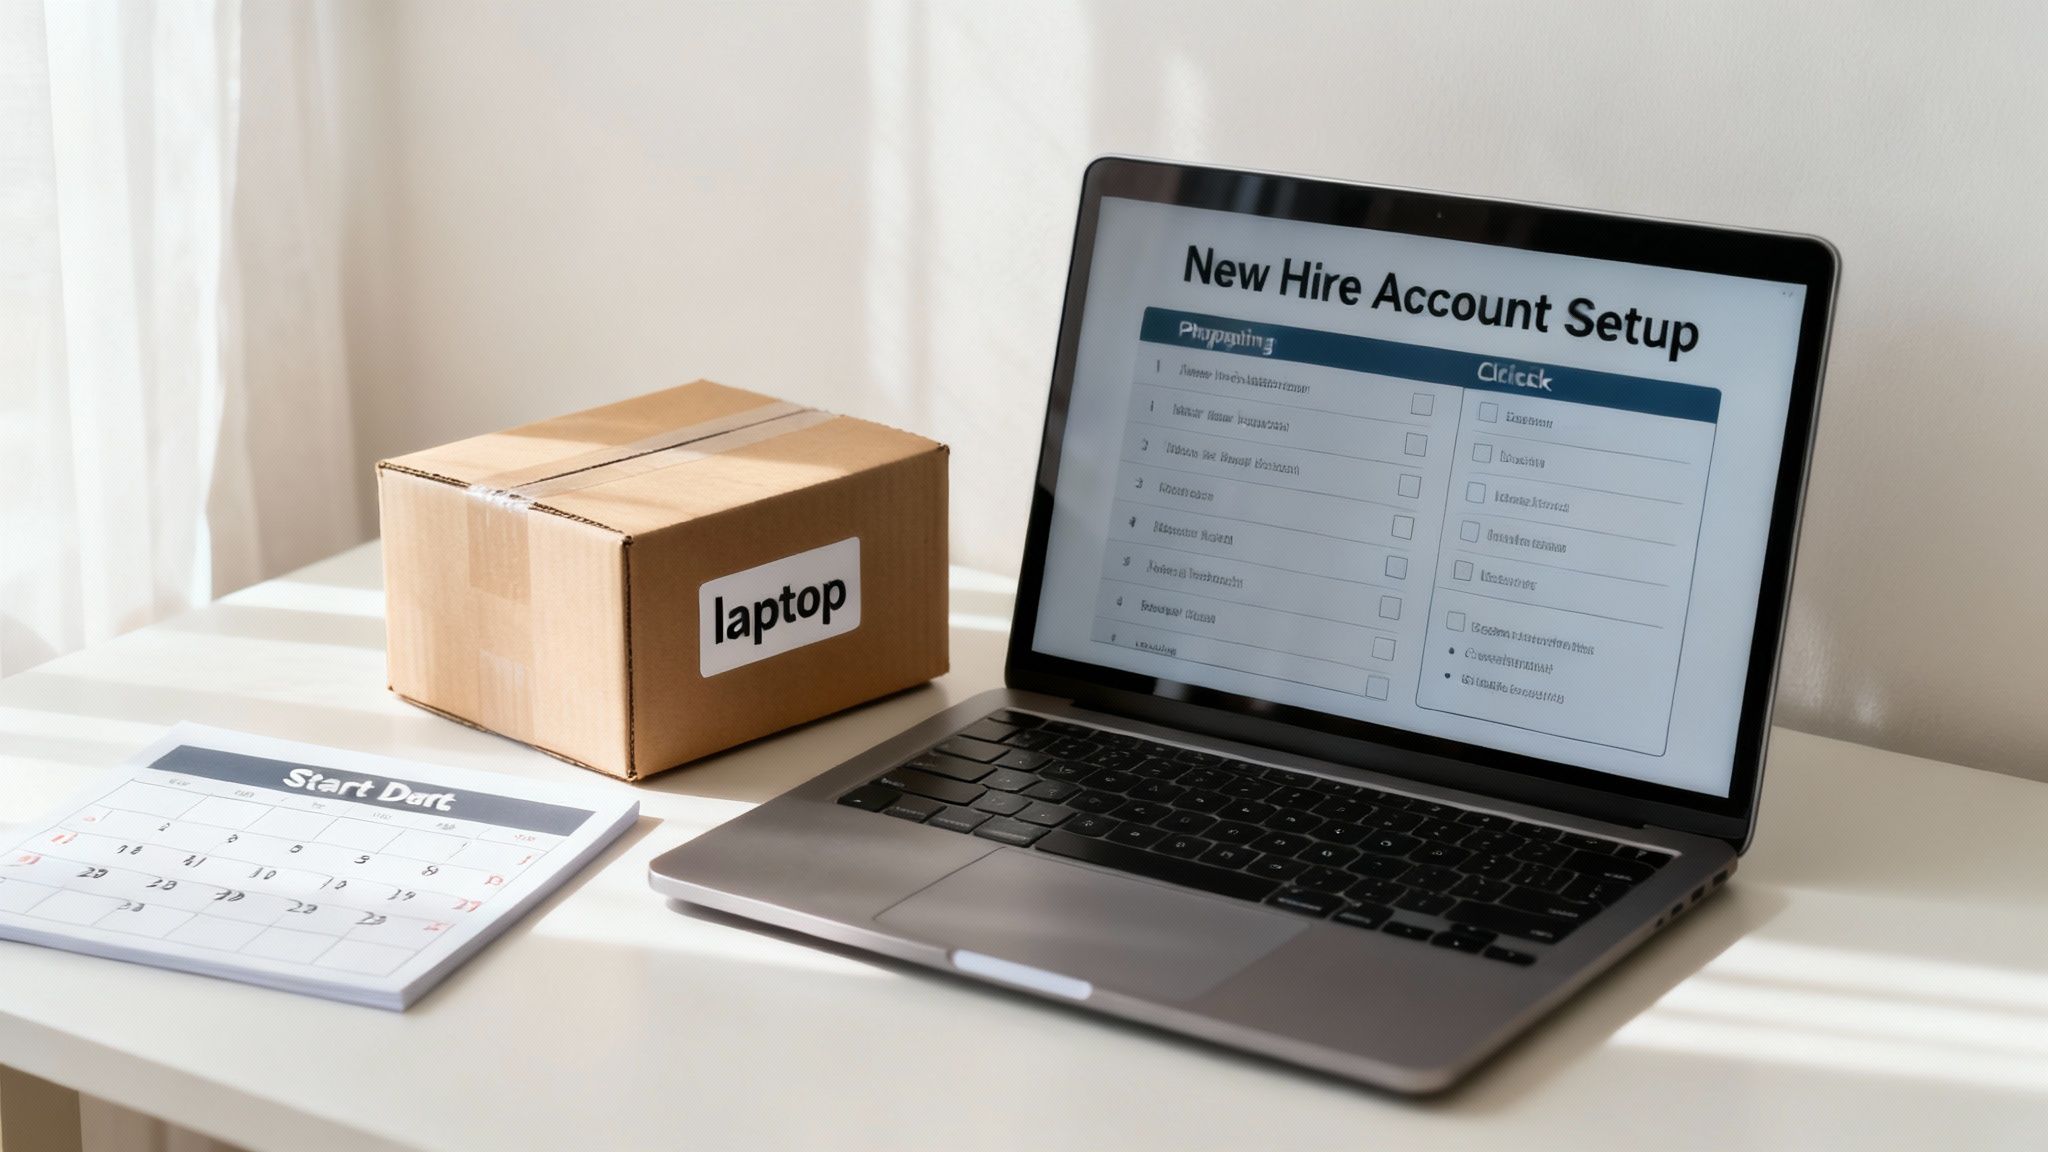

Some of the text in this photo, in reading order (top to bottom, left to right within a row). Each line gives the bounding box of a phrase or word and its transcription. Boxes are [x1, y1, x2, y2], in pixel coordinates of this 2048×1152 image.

[1184, 245, 1700, 362] New Hire Account Setup
[715, 579, 847, 645] laptop
[283, 768, 375, 798] Start
